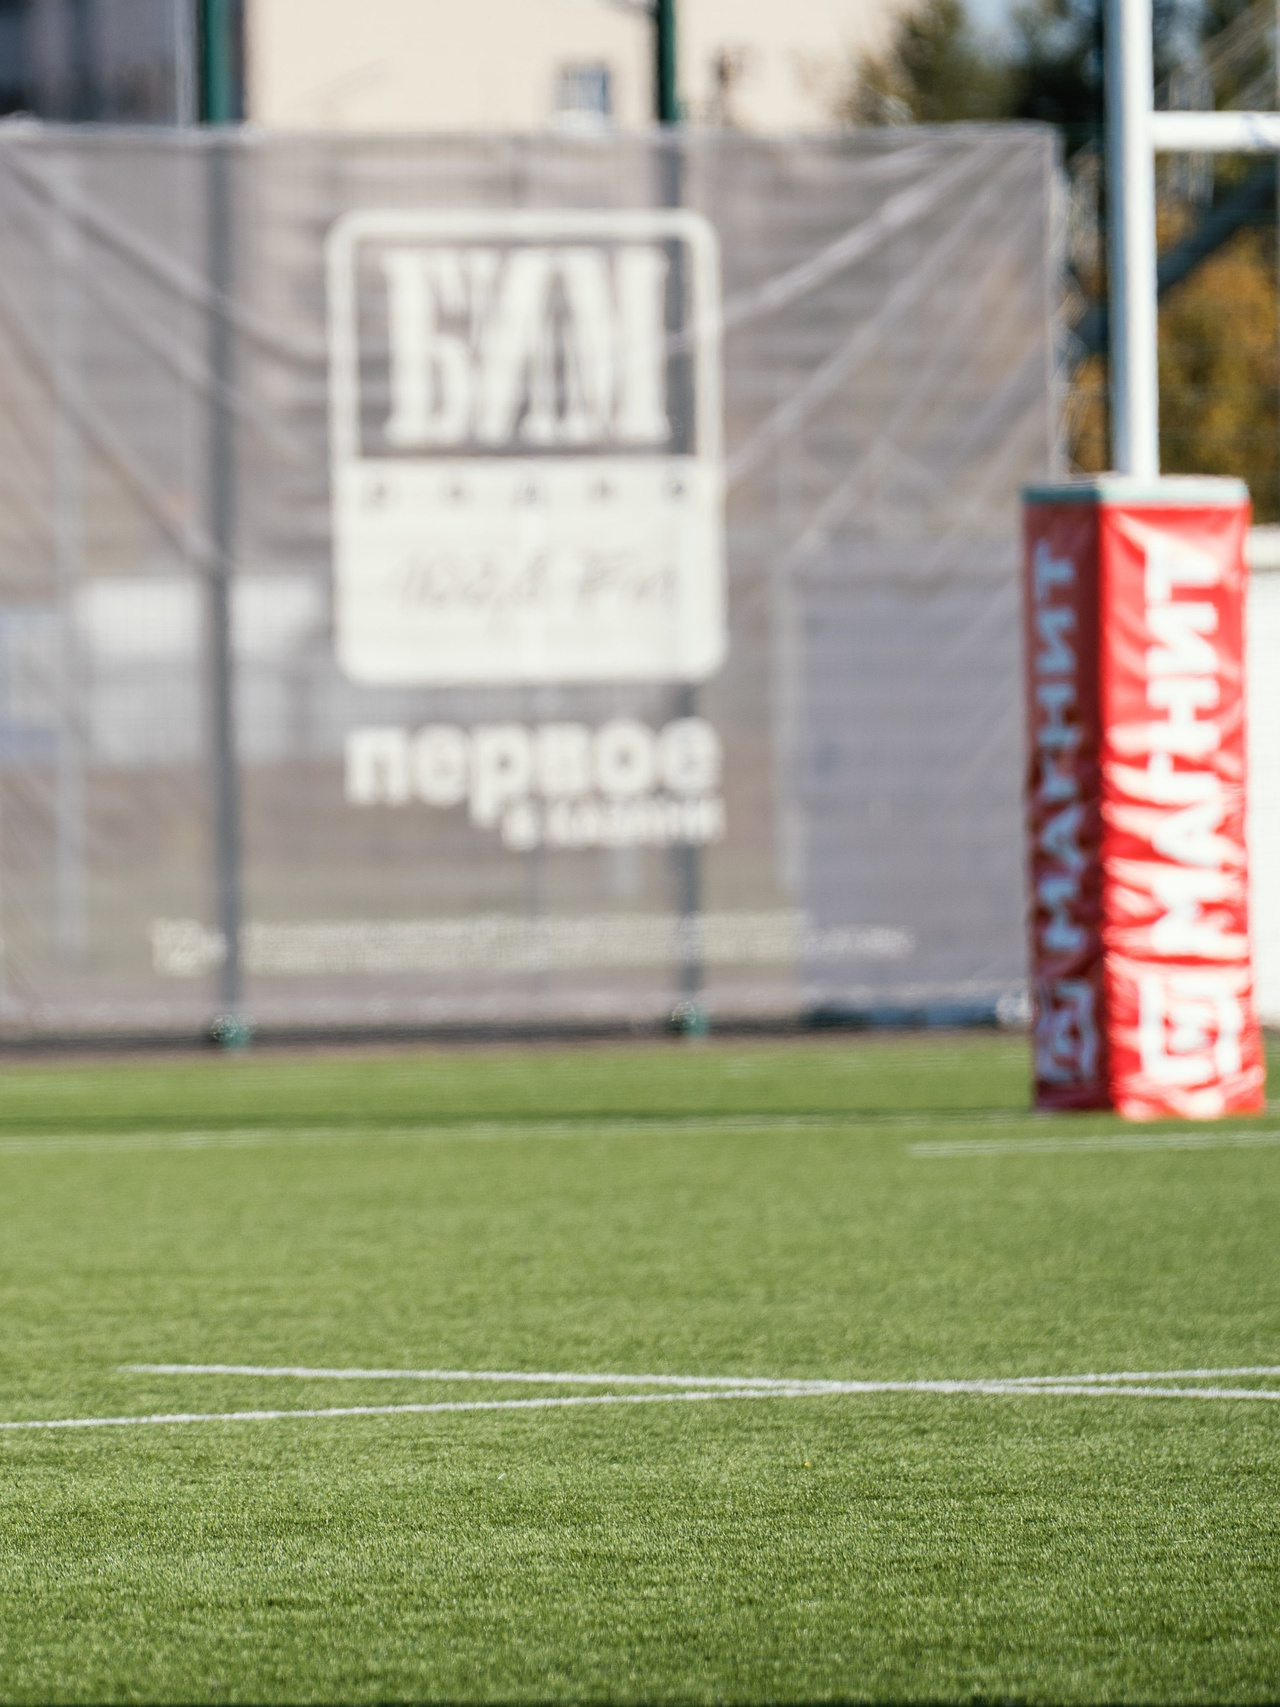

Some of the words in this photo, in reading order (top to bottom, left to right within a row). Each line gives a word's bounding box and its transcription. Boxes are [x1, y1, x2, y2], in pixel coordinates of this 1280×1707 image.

[383, 247, 670, 446] БИМ
[345, 718, 720, 829] первое
[1035, 537, 1086, 952] МАГНИТ
[1145, 535, 1235, 955] МАГНИТ
